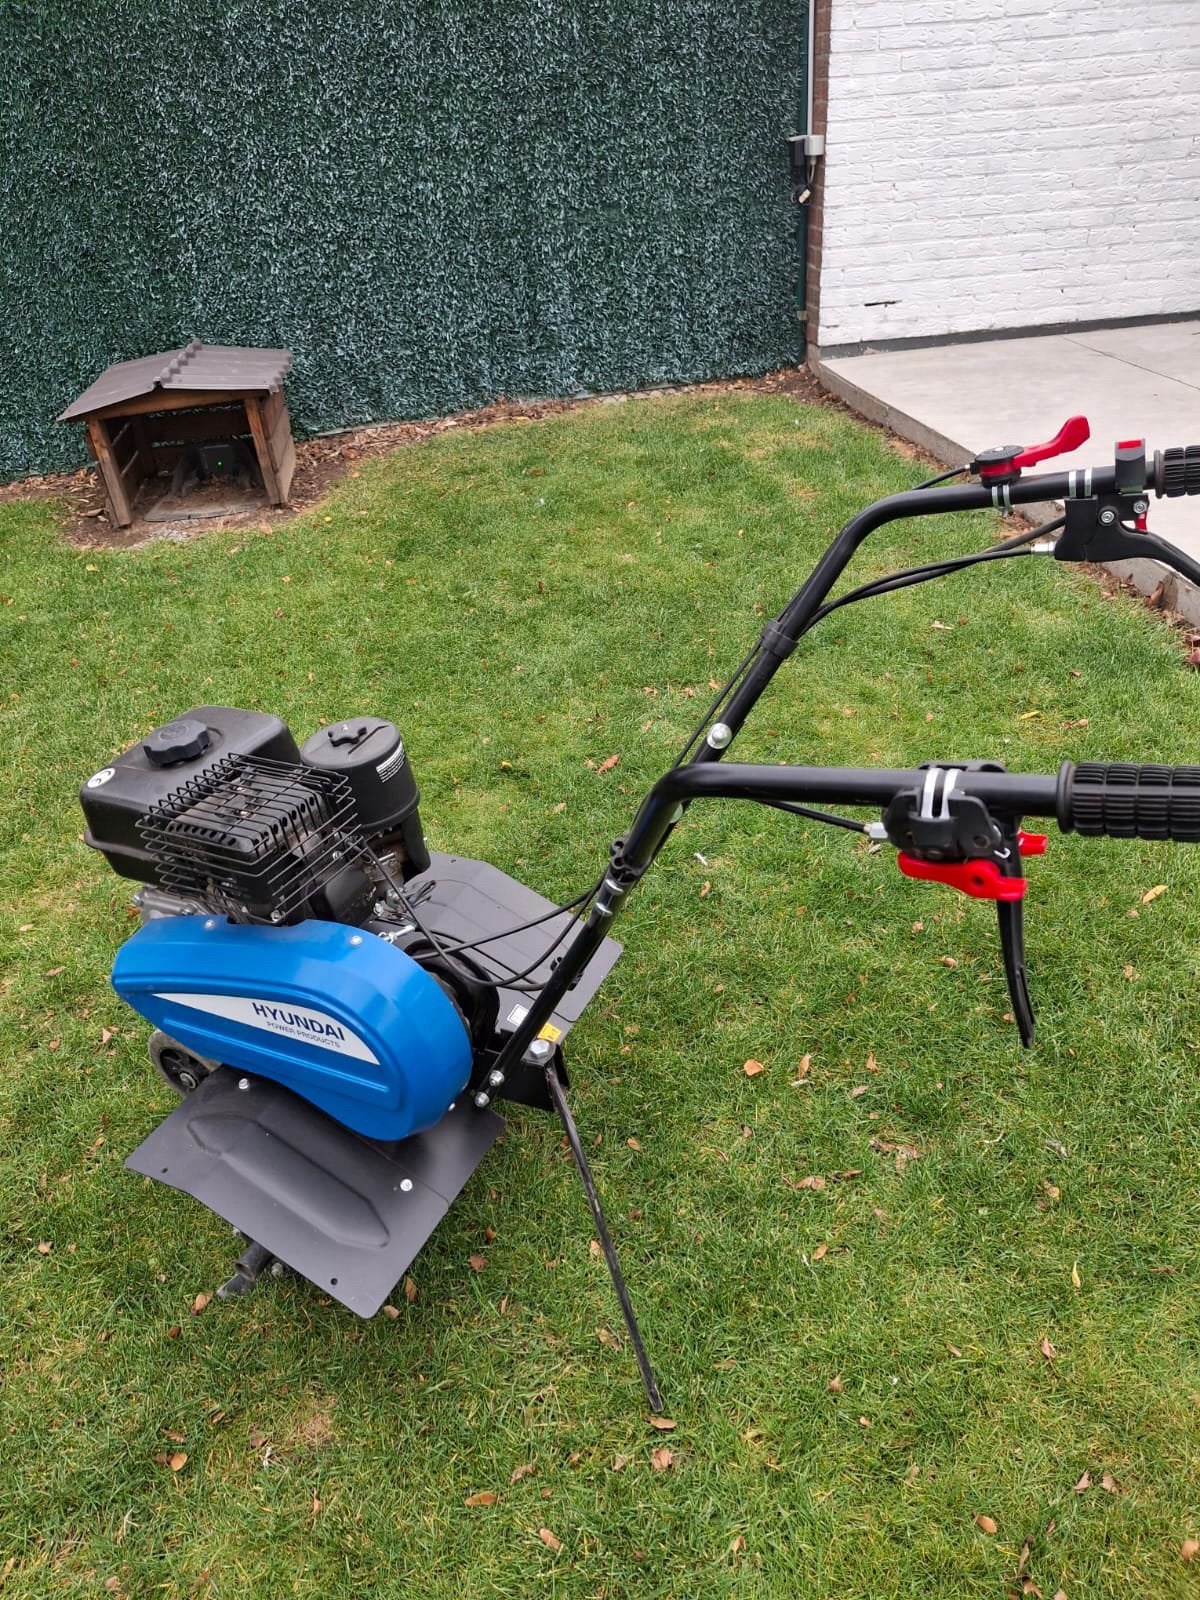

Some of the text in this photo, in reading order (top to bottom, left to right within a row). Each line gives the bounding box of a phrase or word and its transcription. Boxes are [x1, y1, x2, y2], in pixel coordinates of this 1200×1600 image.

[252, 1002, 346, 1041] HYUNDAI
[266, 1021, 341, 1048] POWER PRODUCTS
